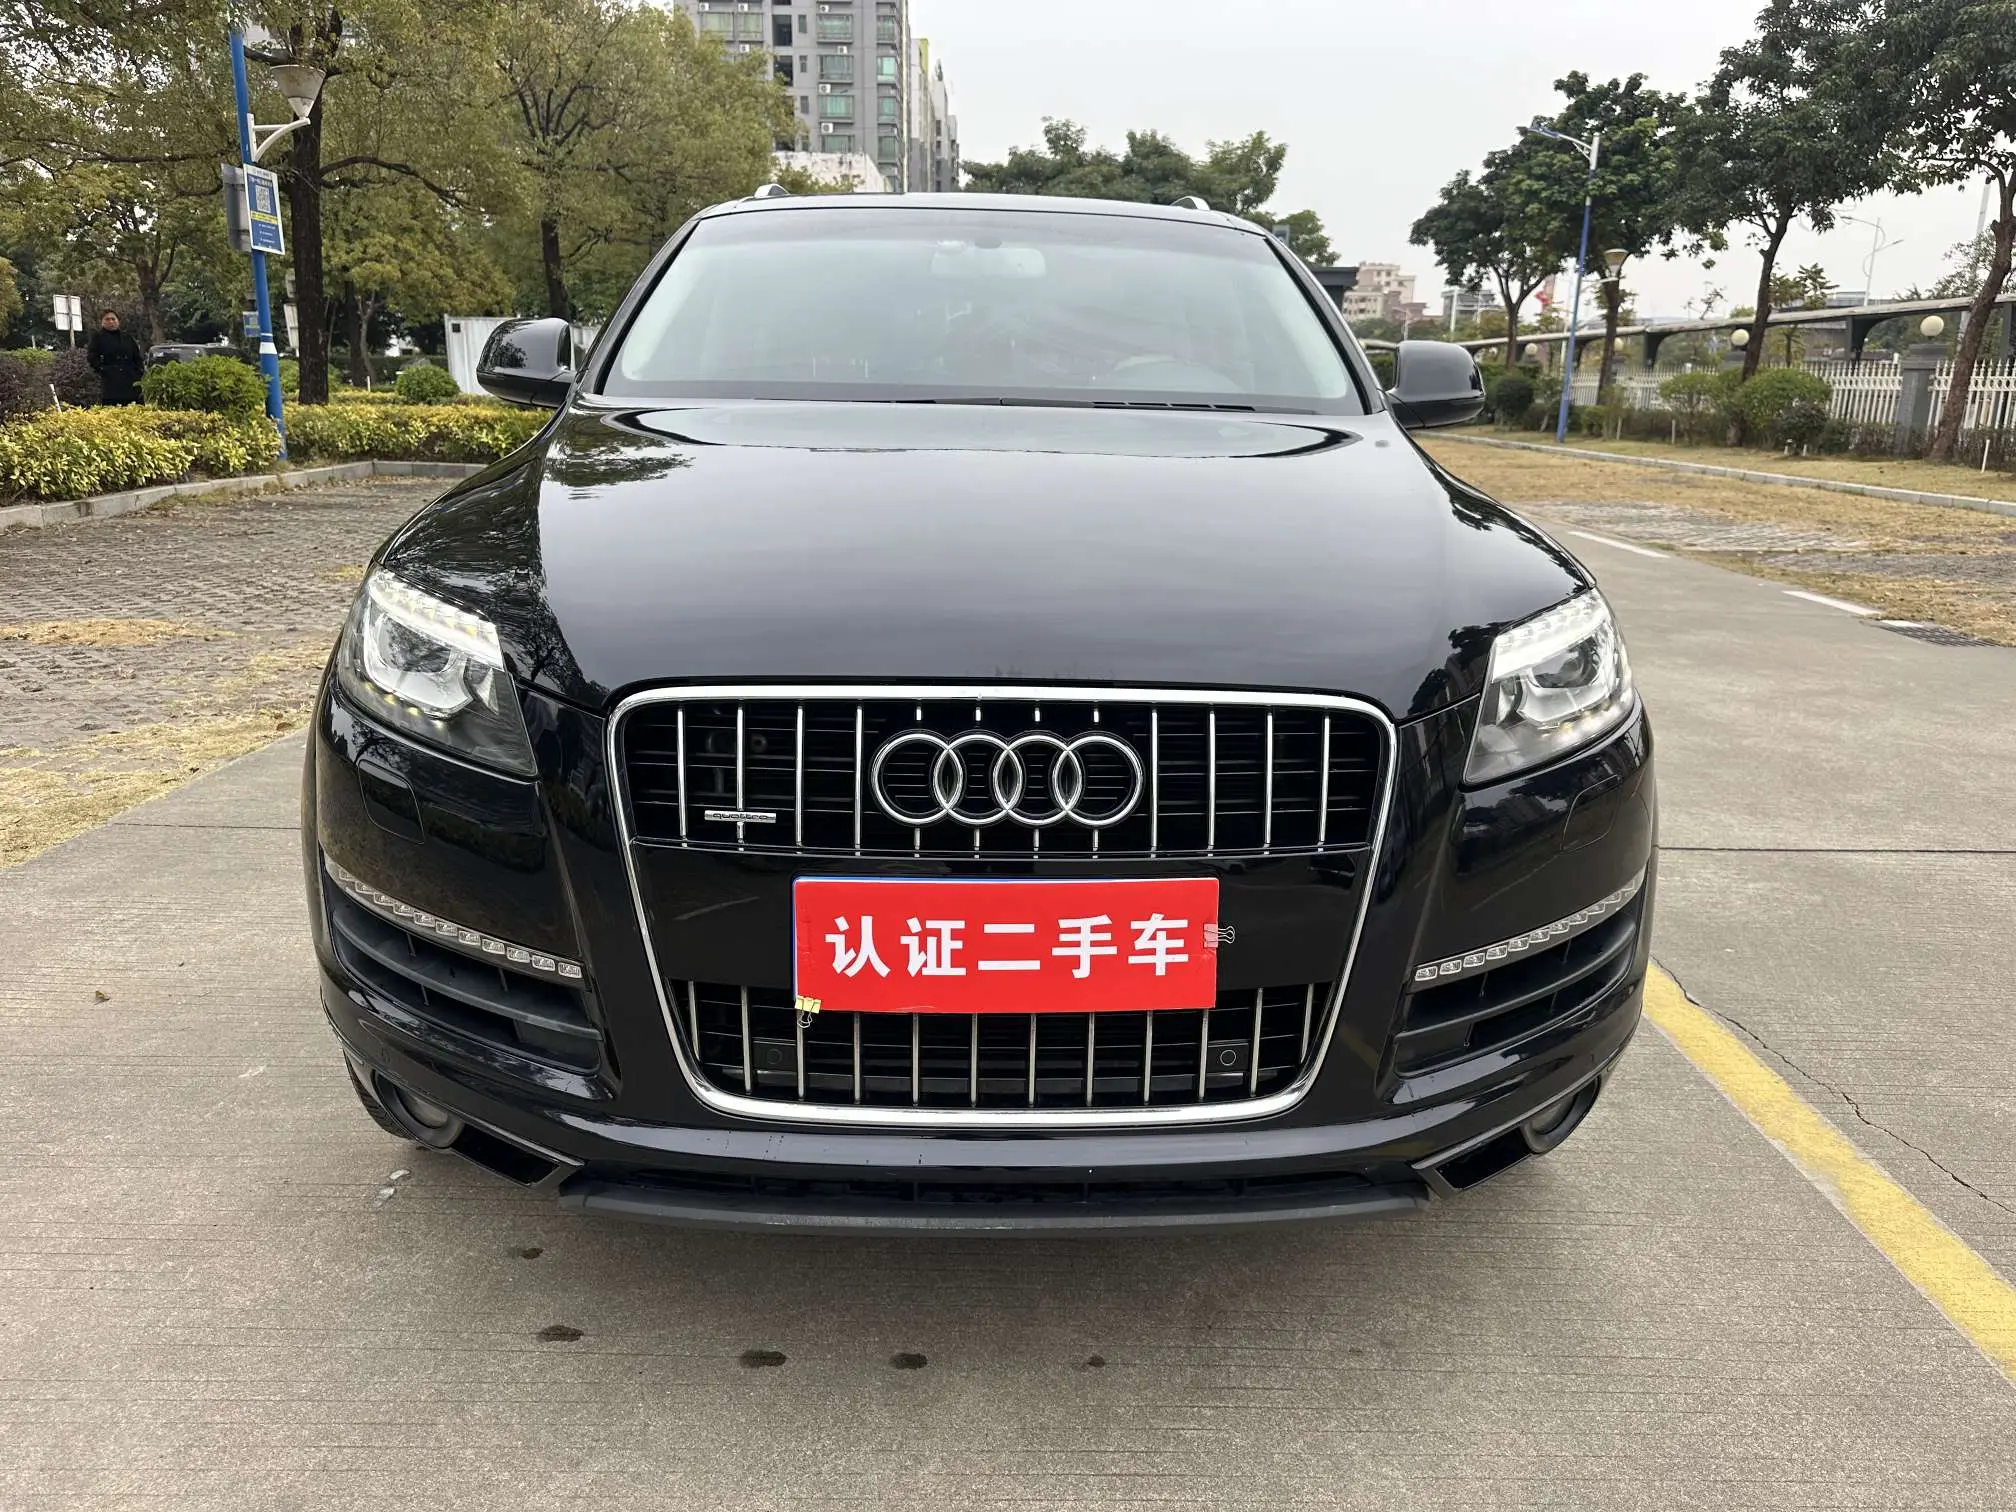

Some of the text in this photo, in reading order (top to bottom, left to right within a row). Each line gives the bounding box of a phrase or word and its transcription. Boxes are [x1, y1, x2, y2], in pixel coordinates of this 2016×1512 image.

[712, 812, 769, 821] quattro
[825, 913, 1189, 978] 认证二手车
